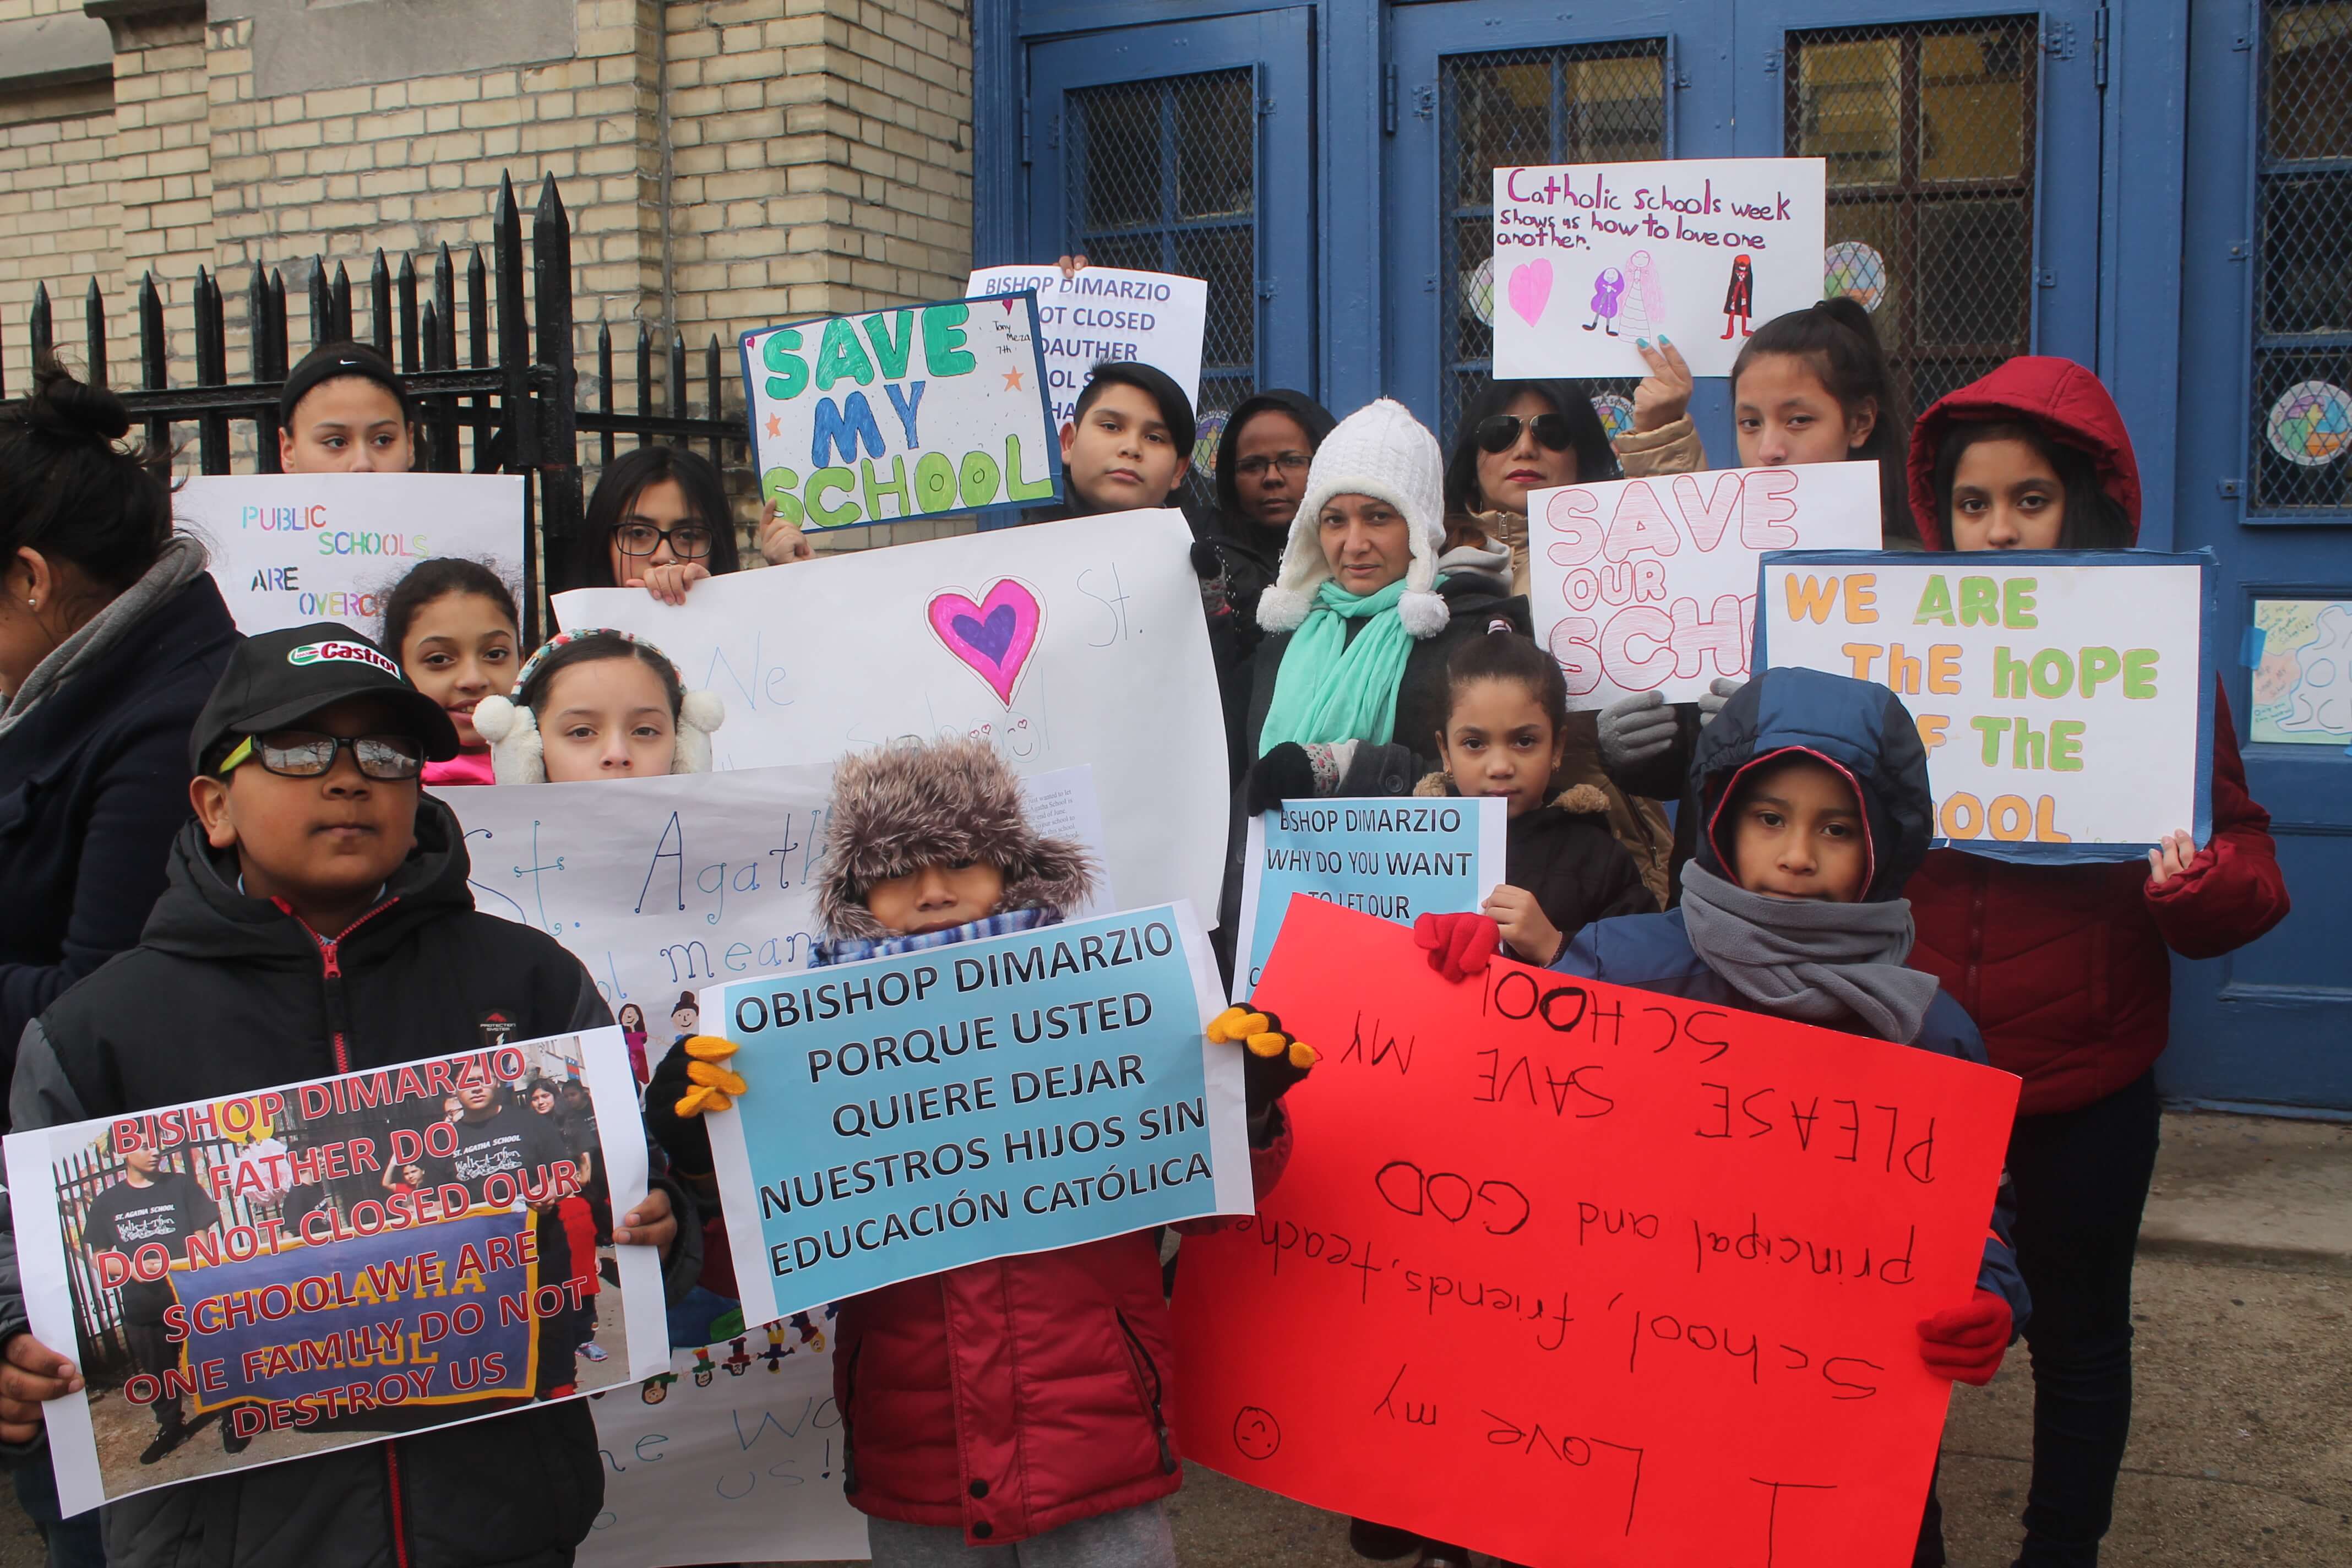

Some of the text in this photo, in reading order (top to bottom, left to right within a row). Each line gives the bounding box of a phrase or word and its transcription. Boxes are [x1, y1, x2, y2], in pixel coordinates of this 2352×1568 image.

[1507, 168, 1622, 210] Catholic
[1732, 191, 1791, 221] week
[1497, 227, 1591, 251] another.
[1562, 214, 1581, 230] us
[1591, 211, 1639, 236] how
[1642, 213, 1670, 239] to
[1676, 215, 1720, 246] love
[1723, 232, 1766, 250] one
[985, 276, 1171, 302] BISHOP DIMARZIO
[993, 321, 1011, 333] Tony
[1006, 333, 1031, 342] Meza
[1039, 306, 1155, 331] OT CLOSED
[763, 303, 977, 400] SAVE
[996, 346, 1012, 354] 7th
[812, 380, 926, 469] MY
[762, 434, 1055, 529] SCHOOL
[243, 504, 327, 531] PUBLIC
[318, 531, 429, 558] SCHOOLS
[1547, 469, 1799, 566] SAVE
[251, 567, 299, 592] ARE
[299, 591, 379, 617] OVERC
[1075, 561, 1144, 647] St.
[1562, 559, 1667, 611] OUR
[1784, 573, 2039, 630] WE ARE
[321, 643, 399, 677] Castrol
[1549, 594, 1758, 695] SCH
[1917, 714, 1950, 759] F
[1049, 799, 1066, 808] School
[1052, 816, 1068, 825] school
[1058, 824, 1075, 832] school
[1280, 809, 1461, 832] BISHOP DIMARZIO
[1931, 791, 2072, 843] OOL
[634, 810, 826, 924] Agath
[1267, 848, 1473, 876] WHY DO YOU WANT
[1369, 895, 1410, 919] OUR
[735, 921, 1174, 1034] OBISHOP DIMARZIO
[808, 991, 1152, 1084] PORQUE USTED
[1482, 963, 1729, 1064] SCHOOL
[111, 1047, 526, 1155] BISHOP DIMARZIO
[832, 1053, 1146, 1140] QUIERE DEJAR
[1341, 1010, 1935, 1184] PLEASE SAVE MY
[209, 1120, 460, 1201] FATHER DO
[463, 1141, 491, 1155] AGATHA
[492, 1135, 521, 1146] SCHOOL
[759, 1096, 1206, 1221] NUESTROS HIJOS SIN
[96, 1159, 582, 1291] DO NOT CLOSED OUR
[124, 1208, 149, 1218] AGATHA
[150, 1204, 175, 1214] SCHOOL
[770, 1152, 1213, 1278] EDUCACIÓN CATÓLICA
[1375, 1161, 1915, 1284] principal and GOD
[164, 1271, 357, 1342] SCHOOL
[366, 1250, 442, 1297] WE
[456, 1230, 540, 1280] ARE
[1224, 1210, 1381, 1305] teache
[123, 1276, 588, 1406] ONE FAMILY DO NOT
[232, 1352, 507, 1439] DESTROY US
[1374, 1363, 1437, 1425] my
[1481, 1409, 1643, 1536] Love
